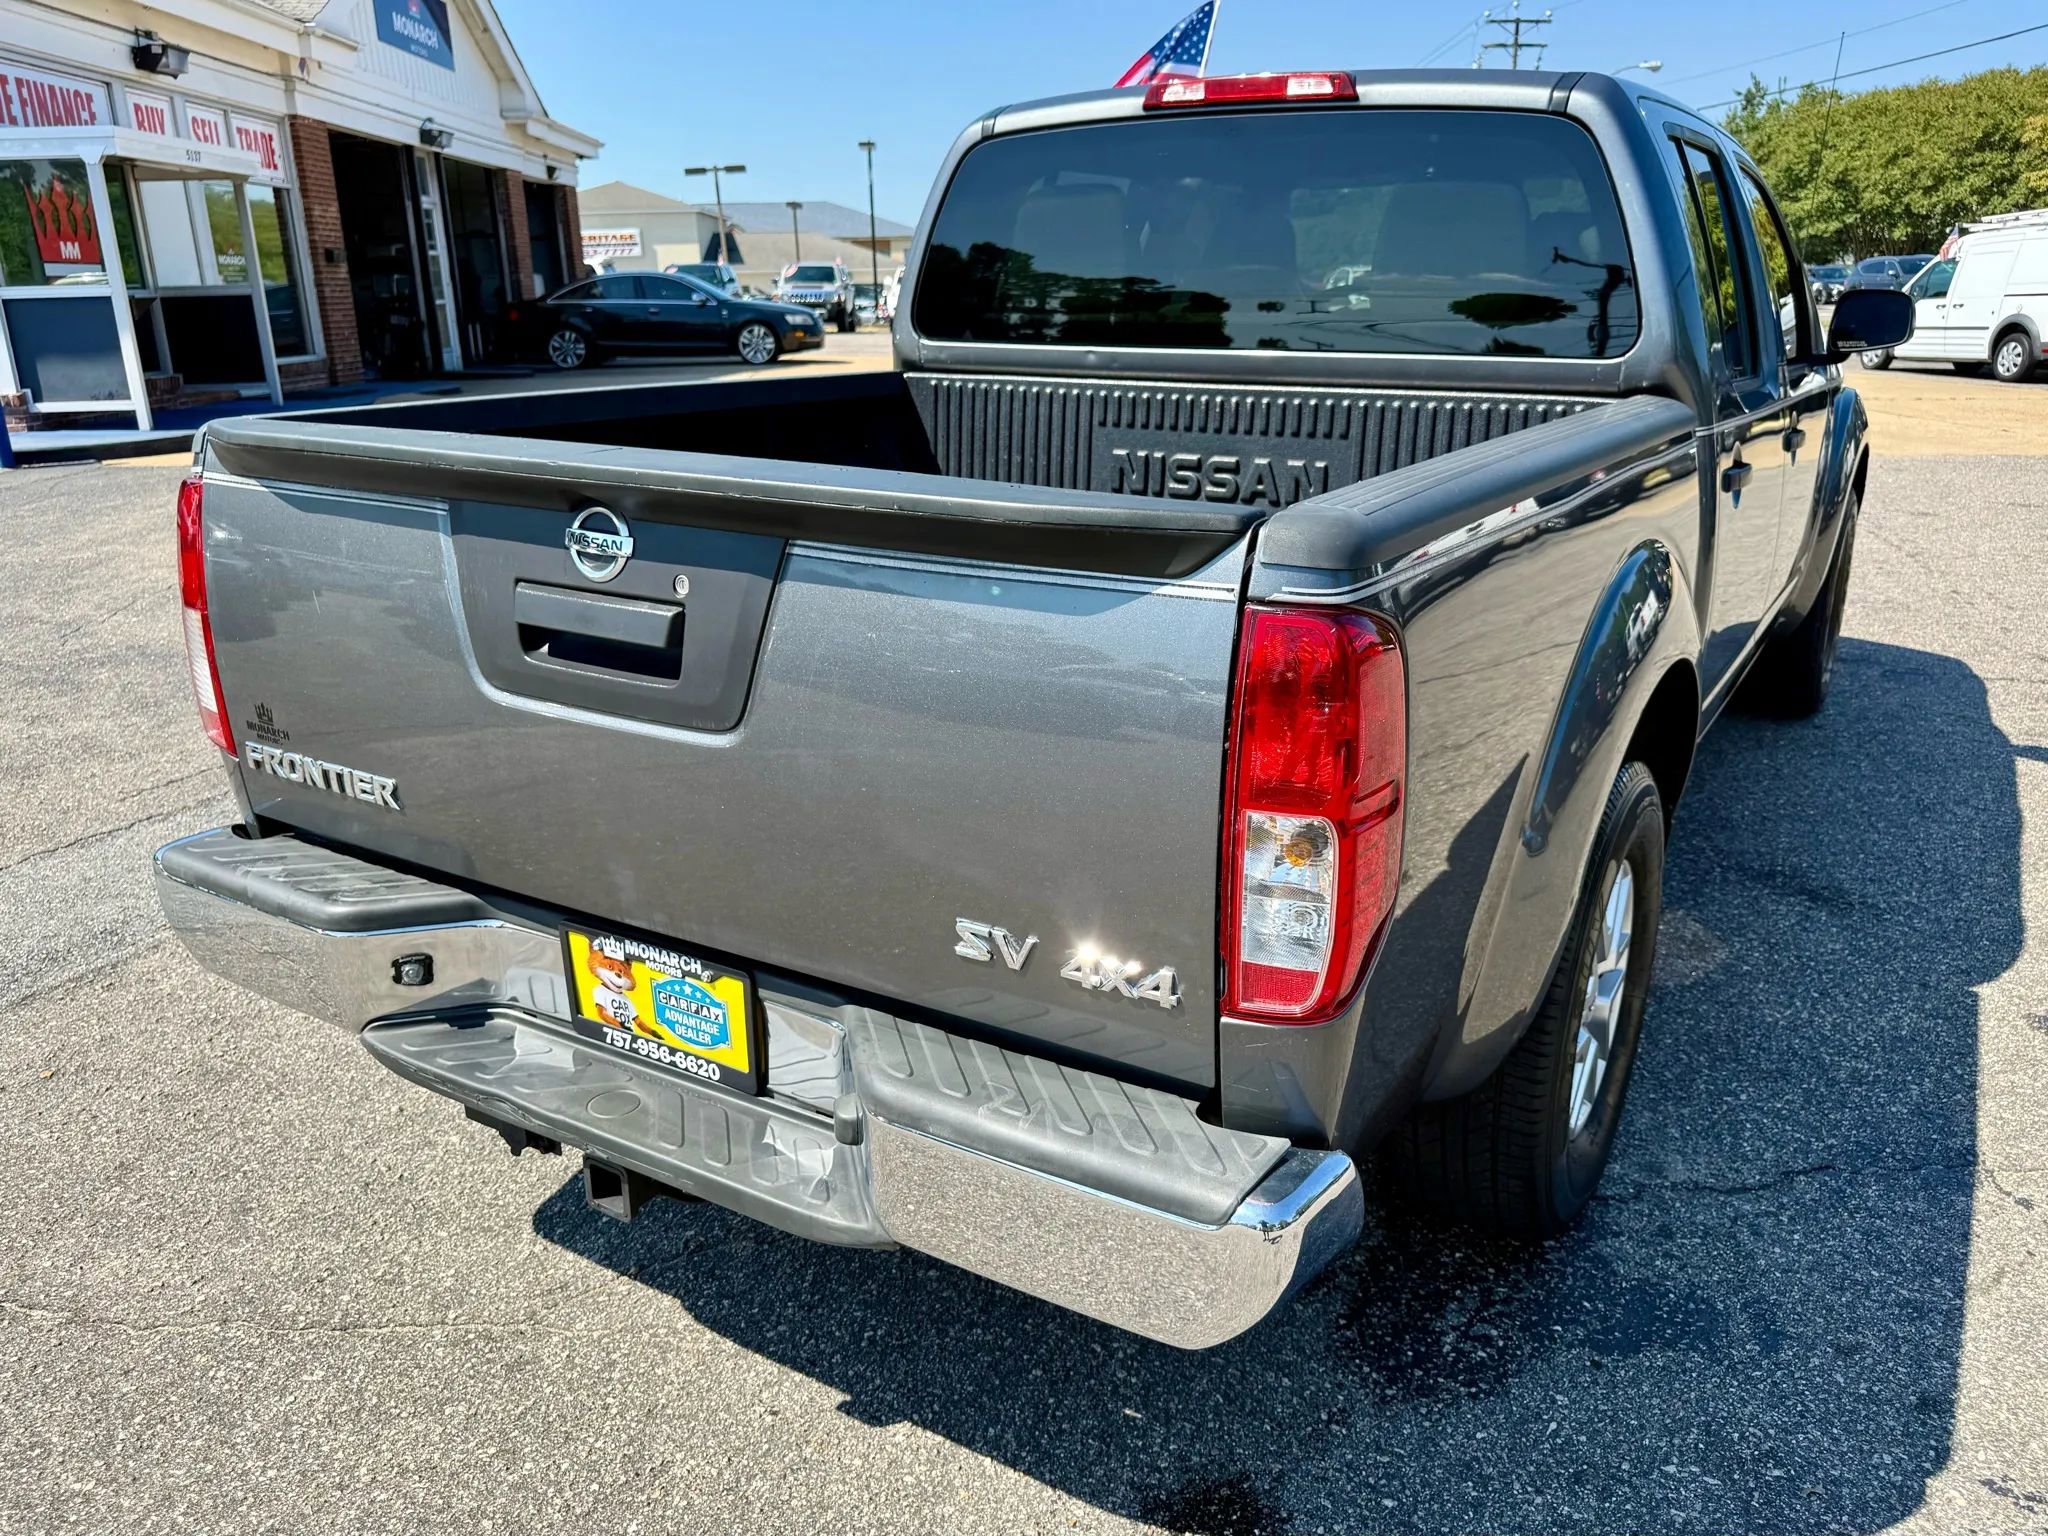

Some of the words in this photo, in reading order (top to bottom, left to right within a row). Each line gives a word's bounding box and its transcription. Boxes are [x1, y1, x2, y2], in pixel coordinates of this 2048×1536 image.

[392, 11, 439, 50] MONARCH
[236, 126, 278, 171] TRADE
[217, 254, 247, 265] MONARCH
[1111, 447, 1331, 506] NISSAN
[568, 530, 624, 553] NISSAN
[246, 719, 291, 742] MONARCH
[245, 740, 401, 811] FRONTIER
[624, 939, 702, 975] MONARCH
[953, 916, 1040, 972] SV
[645, 960, 683, 978] MOTORS
[610, 998, 630, 1012] CAR
[613, 1010, 633, 1026] FOX
[657, 990, 724, 1022] CARFAX
[664, 1008, 721, 1036] ADVANTAGE
[674, 1023, 712, 1046] DEALER
[602, 1026, 721, 1082] 757-956-6620
